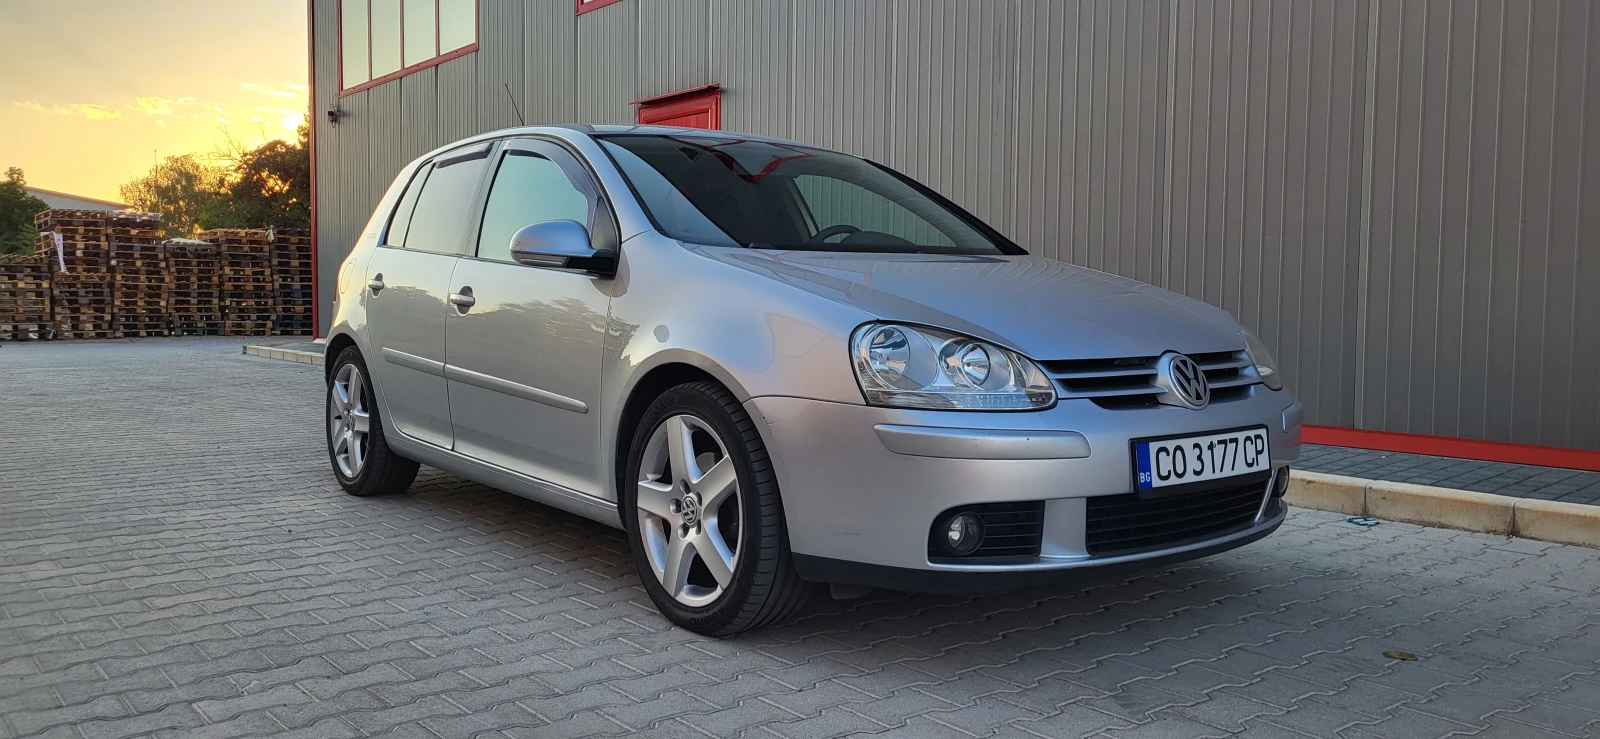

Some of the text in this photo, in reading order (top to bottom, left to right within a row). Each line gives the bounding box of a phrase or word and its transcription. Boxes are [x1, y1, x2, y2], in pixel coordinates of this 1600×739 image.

[1171, 356, 1208, 407] VW
[1139, 472, 1151, 483] BG
[1155, 433, 1265, 481] CO 3177 CP
